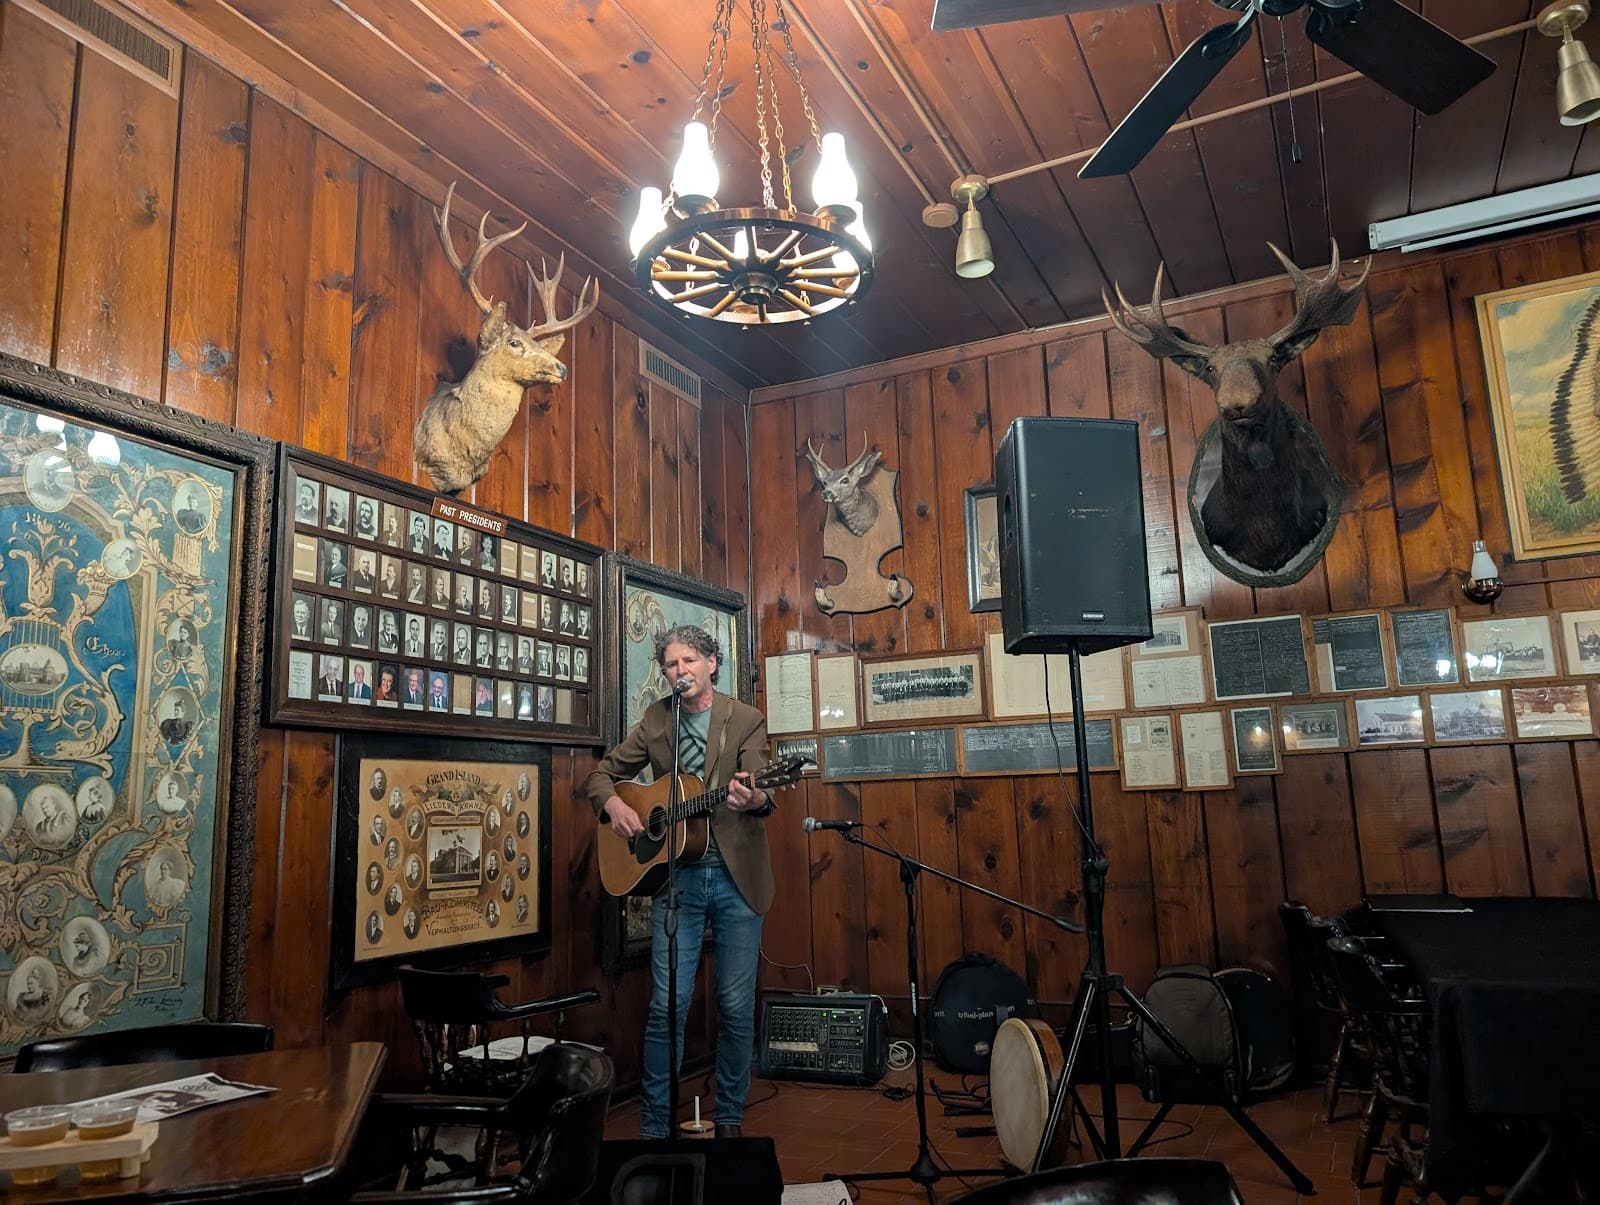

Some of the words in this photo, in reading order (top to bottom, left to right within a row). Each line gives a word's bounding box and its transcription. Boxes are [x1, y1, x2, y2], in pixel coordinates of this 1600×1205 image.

[439, 504, 456, 517] PAST
[459, 510, 502, 532] PRESIDENTS
[426, 770, 454, 785] GRAND
[455, 769, 481, 785] ISLAND
